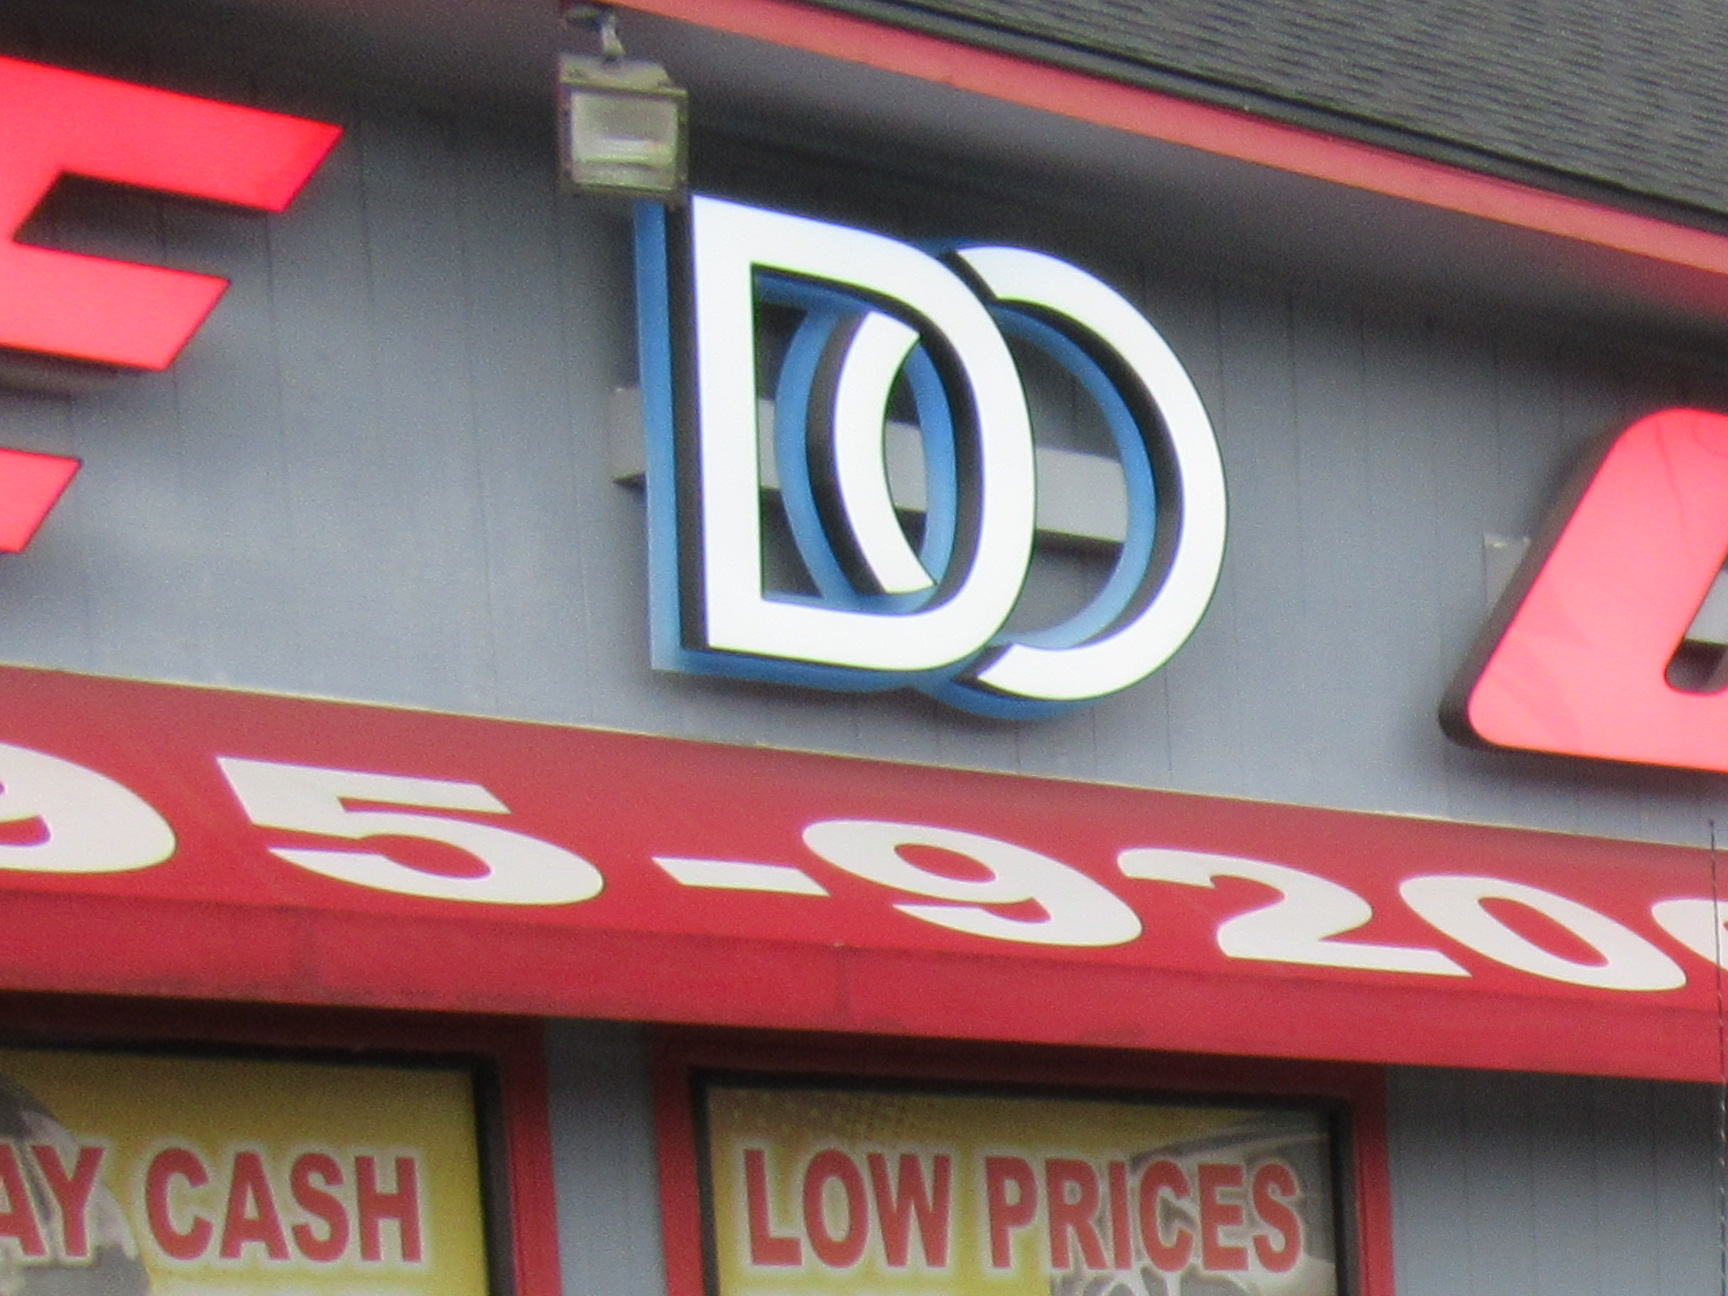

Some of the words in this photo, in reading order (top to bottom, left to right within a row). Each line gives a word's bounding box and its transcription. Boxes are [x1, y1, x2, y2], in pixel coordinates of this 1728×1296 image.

[144, 1147, 425, 1263] CASH
[743, 1147, 953, 1269] LOW
[984, 1154, 1302, 1273] PRICES
